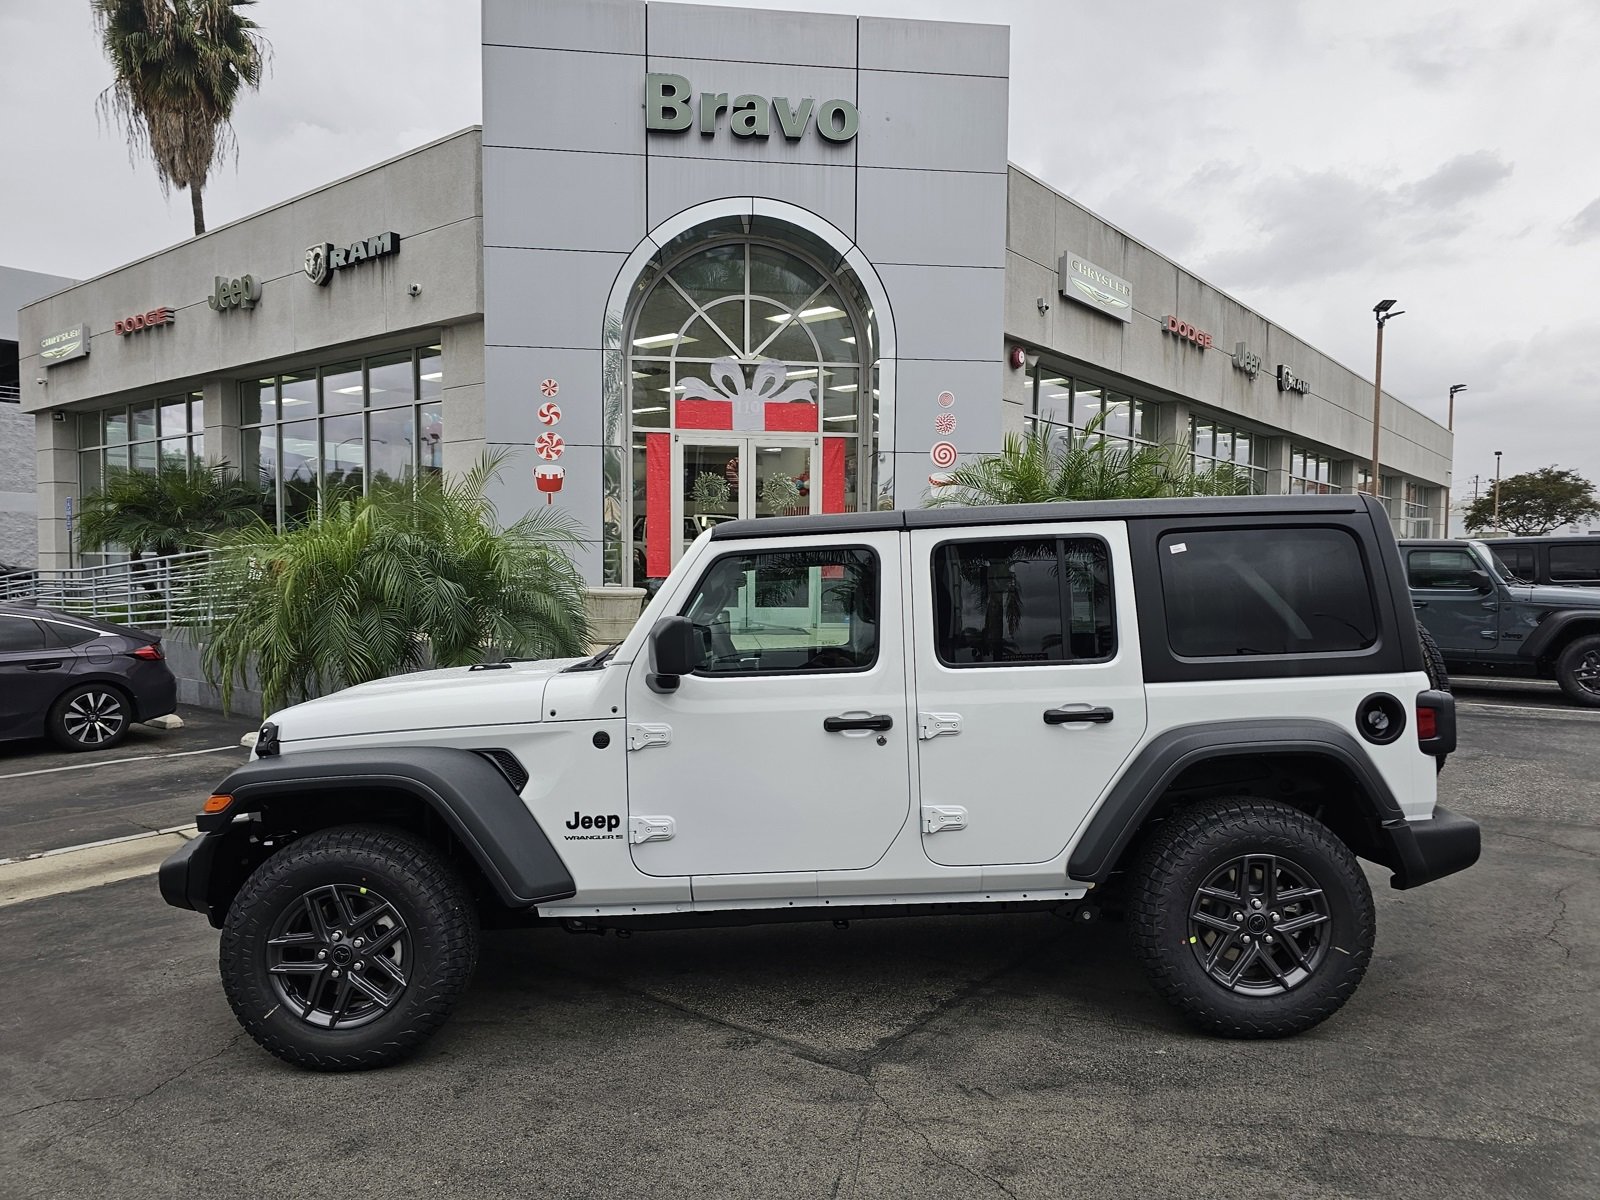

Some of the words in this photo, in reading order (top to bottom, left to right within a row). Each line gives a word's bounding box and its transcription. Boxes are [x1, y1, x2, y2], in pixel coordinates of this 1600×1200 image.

[646, 73, 859, 143] Bravo
[329, 231, 396, 270] RAM
[208, 274, 259, 311] Jeep
[1070, 260, 1130, 297] CHRYSLER
[114, 307, 171, 336] DODGE
[1167, 315, 1213, 349] DODGE
[1234, 342, 1262, 377] Jeep
[1290, 377, 1310, 394] RAM
[565, 811, 620, 832] Jeep
